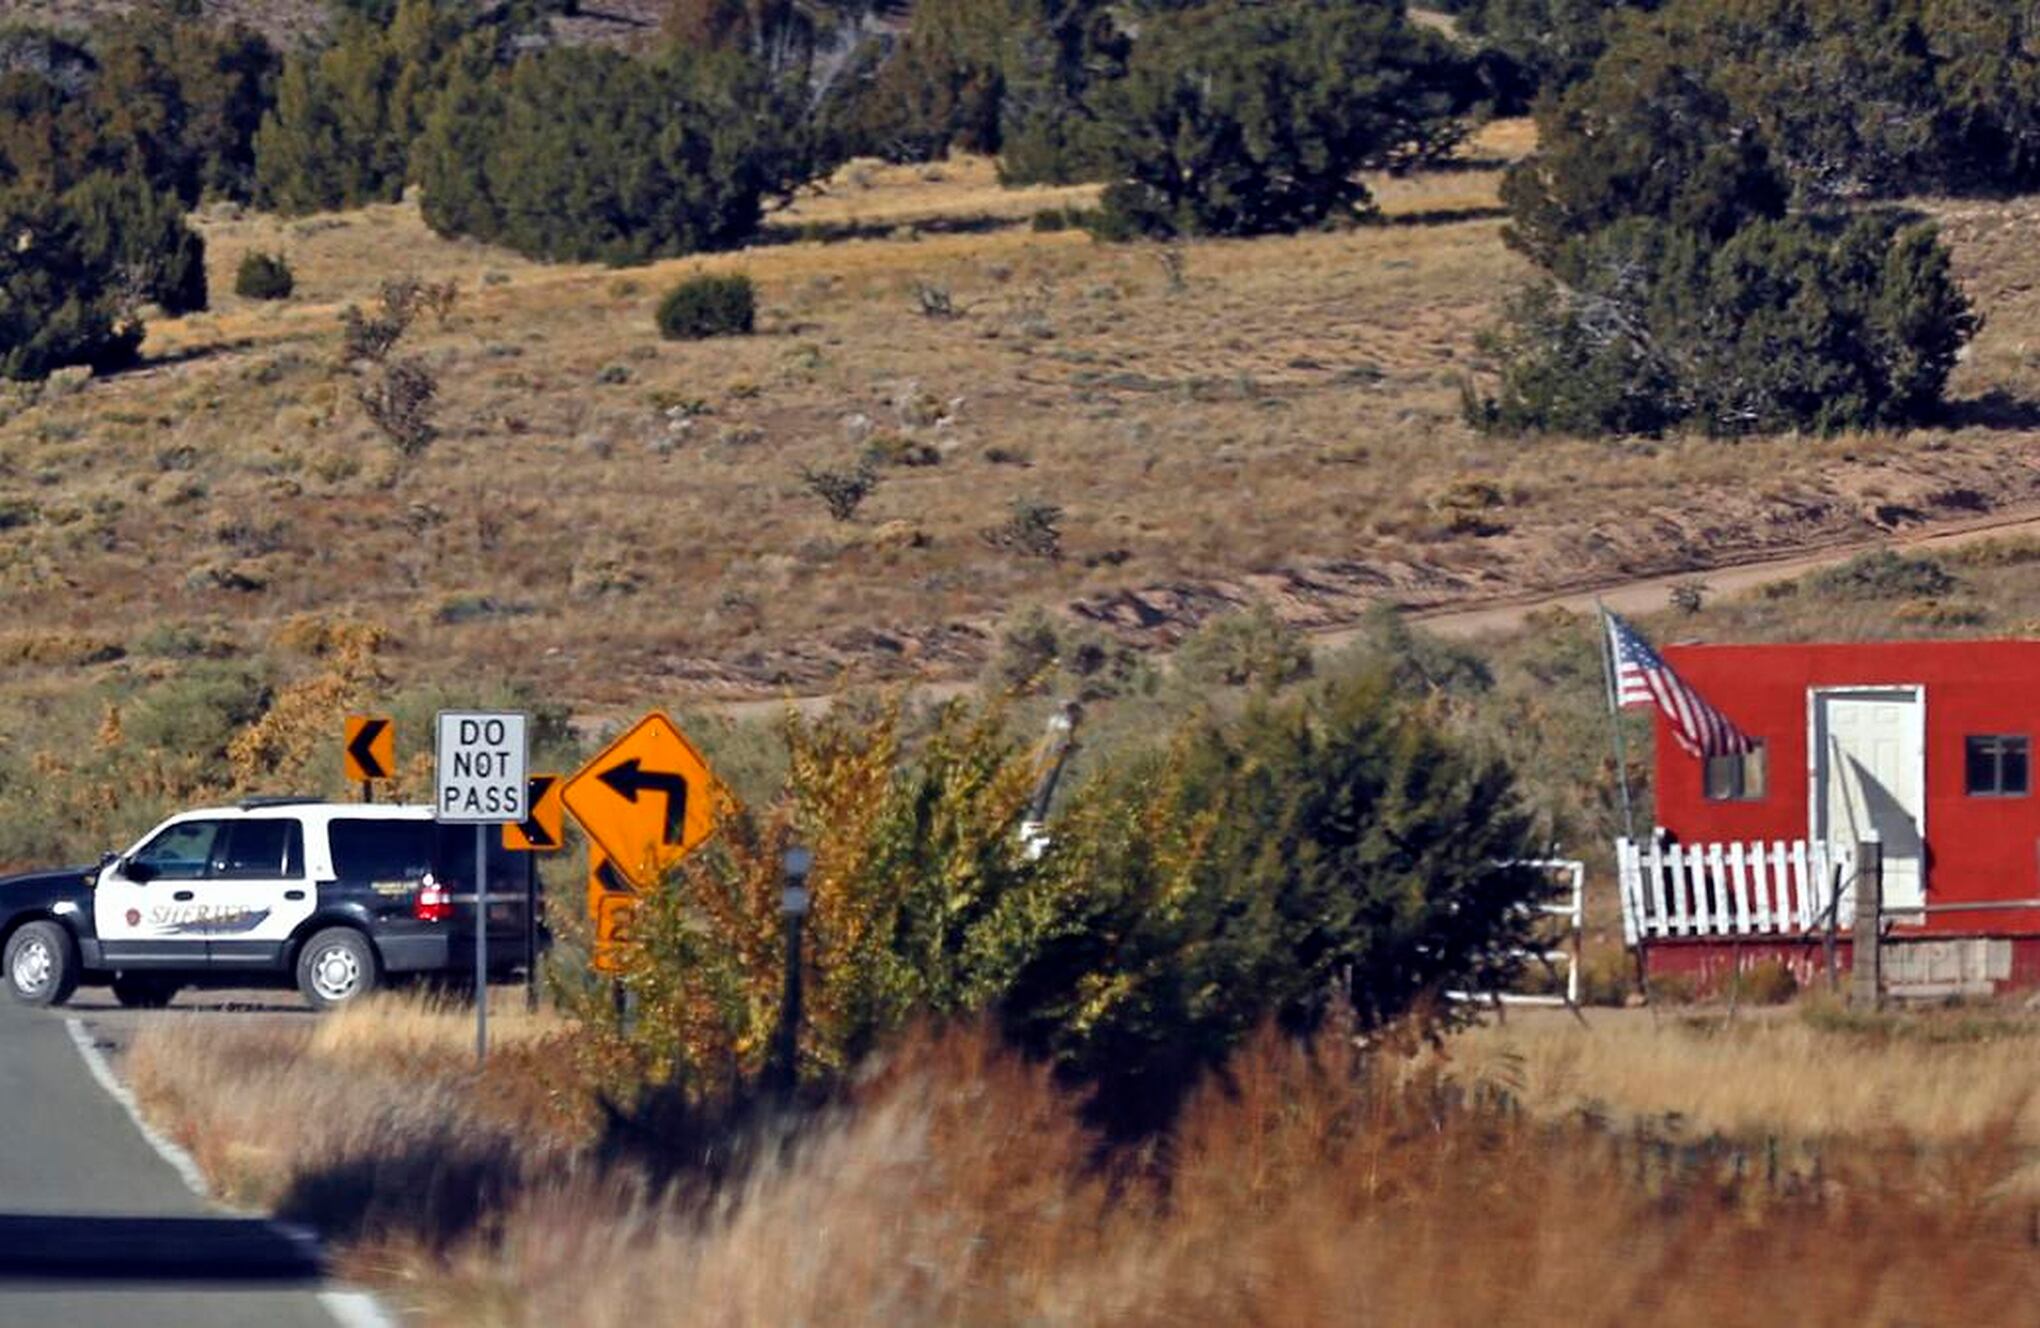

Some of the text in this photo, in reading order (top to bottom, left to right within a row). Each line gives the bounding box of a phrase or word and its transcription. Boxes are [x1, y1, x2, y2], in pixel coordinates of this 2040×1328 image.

[460, 719, 505, 746] DO
[453, 751, 511, 778] NOT
[444, 786, 519, 813] PASS
